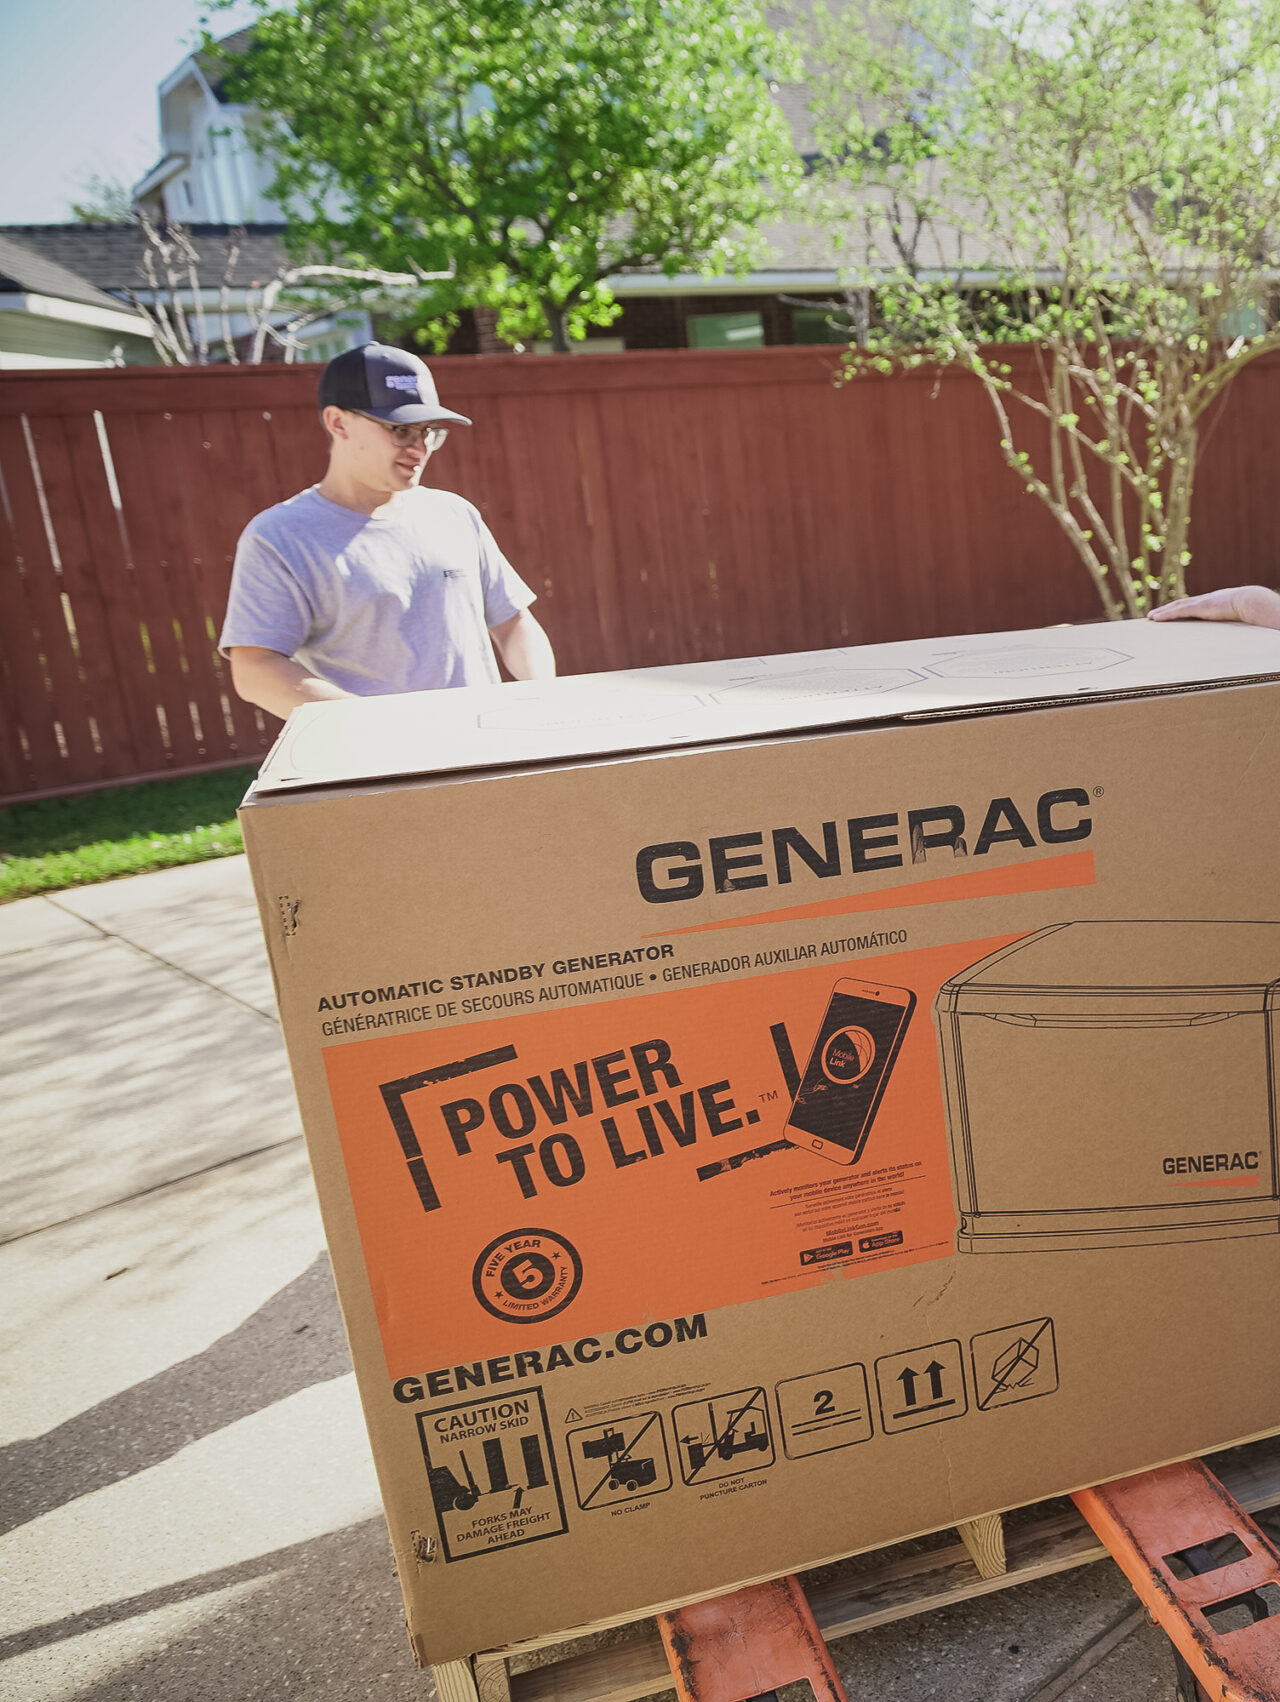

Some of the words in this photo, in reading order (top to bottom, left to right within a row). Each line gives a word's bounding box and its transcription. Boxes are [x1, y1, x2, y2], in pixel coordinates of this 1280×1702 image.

[317, 979, 444, 1012] AUTOMATIC
[450, 963, 546, 992] STANDBY
[552, 944, 675, 975] GENERATOR
[321, 1005, 431, 1037] GÉNÉRATRICE
[436, 1001, 457, 1018] DE
[462, 989, 535, 1014] SECOURS
[539, 972, 644, 1003] AUTOMATIQUE
[662, 955, 751, 982] GENERADOR
[754, 944, 818, 968] AUXILIAR
[820, 929, 908, 956] AUTOMÁTICO
[829, 1057, 846, 1068] Link
[833, 1049, 855, 1061] Mobile
[440, 1038, 684, 1157] POWER
[495, 1133, 586, 1199] TO
[600, 1079, 761, 1170] LIVE.
[1162, 1151, 1260, 1175] GENERAC
[770, 1186, 793, 1197] Actively
[794, 1182, 818, 1192] monitors
[819, 1179, 832, 1187] your
[833, 1173, 859, 1184] generator
[486, 1252, 506, 1277] FIVE
[504, 1240, 541, 1253] YEAR
[815, 1250, 837, 1261] Google
[512, 1259, 544, 1290] 5
[502, 1300, 539, 1311] LIMITED
[540, 1266, 568, 1306] WARRANTY
[392, 1313, 708, 1403] GENERAC.COM
[434, 1400, 529, 1433] CAUTION
[813, 1390, 835, 1416] 2
[440, 1423, 497, 1444] NARROW
[501, 1416, 529, 1430] SKID
[700, 1486, 737, 1501] PUNCTURE
[739, 1479, 768, 1493] CARTON
[718, 1480, 729, 1489] DO
[730, 1477, 745, 1486] NOT
[472, 1513, 507, 1528] FORKS
[509, 1506, 532, 1519] MAY
[611, 1509, 623, 1518] NO
[624, 1502, 650, 1515] CLAMP
[457, 1523, 505, 1543] DAMAGE
[507, 1512, 551, 1530] FREIGHT
[487, 1529, 525, 1545] AHEAD
